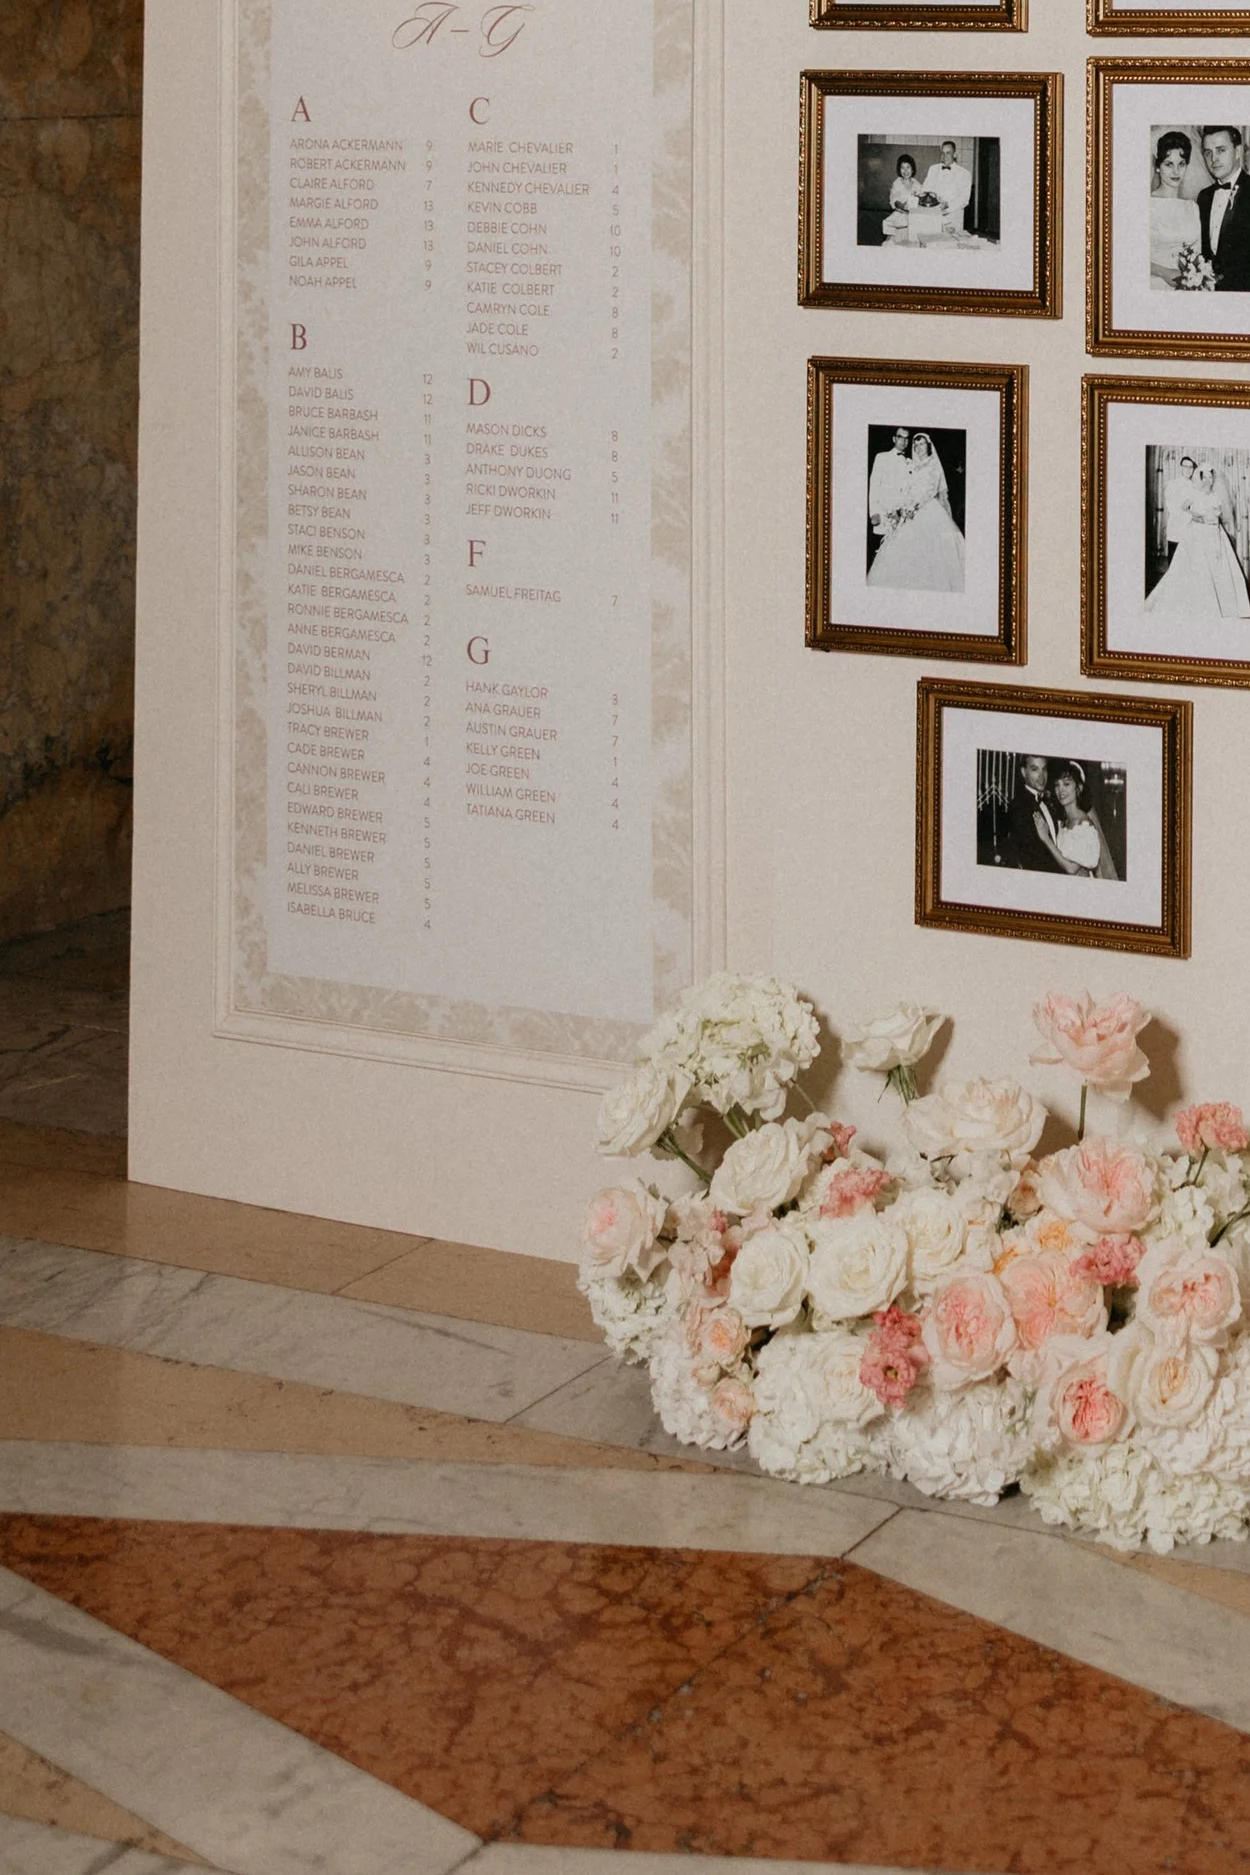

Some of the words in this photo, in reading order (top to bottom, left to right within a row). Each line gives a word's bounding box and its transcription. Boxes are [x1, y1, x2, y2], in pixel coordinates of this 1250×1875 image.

[290, 95, 312, 123] A
[468, 97, 490, 125] C
[289, 138, 329, 149] ARONA
[331, 139, 403, 150] ACKERMANN
[289, 157, 333, 169] ROBERT
[334, 159, 406, 170] ACKERMANN
[467, 180, 522, 194] KENNEDY
[524, 181, 590, 195] CHEVALIER
[288, 196, 331, 208] MARGIE
[333, 197, 379, 210] ALFORD
[467, 201, 502, 213] KEVIN
[503, 201, 537, 214] COBB
[466, 220, 508, 234] DEBBIE
[510, 222, 547, 235] COHN
[289, 236, 320, 248] JOHN
[322, 237, 367, 249] ALFORD
[466, 301, 516, 315] CAMRYN
[518, 303, 550, 317] COLE
[290, 323, 307, 350] B
[288, 385, 322, 398] DAVID
[324, 387, 354, 400] BALIS
[467, 378, 491, 406] D
[288, 405, 324, 418] BRUCE
[327, 407, 378, 421] BARBASH
[465, 422, 509, 435] MASON
[511, 424, 547, 438] DICKS
[287, 445, 333, 458] ALLISON
[335, 447, 365, 460] BEAN
[465, 462, 524, 477] ANTHONY
[525, 466, 571, 481] DUONG
[287, 484, 334, 497] SHARON
[336, 487, 367, 500] BEAN
[287, 543, 313, 556] MIKE
[315, 545, 362, 560] BENSON
[467, 539, 486, 568] F
[287, 623, 318, 636] ANNE
[320, 625, 396, 643] BERGAMESCA
[287, 642, 322, 656] DAVID
[323, 646, 370, 660] BERMAN
[466, 635, 492, 665] G
[464, 701, 490, 714] ANA
[492, 703, 541, 719] GRAUER
[465, 721, 506, 736] AUSTIN
[508, 725, 557, 741] GRAUER
[286, 741, 316, 755] CADE
[319, 745, 365, 760] BREWER
[286, 761, 337, 777] CANNON
[339, 767, 385, 783] BREWER
[286, 801, 334, 817] EDWARD
[336, 807, 383, 823] BREWER
[286, 881, 331, 897] MELISSA
[333, 887, 379, 903] BREWER
